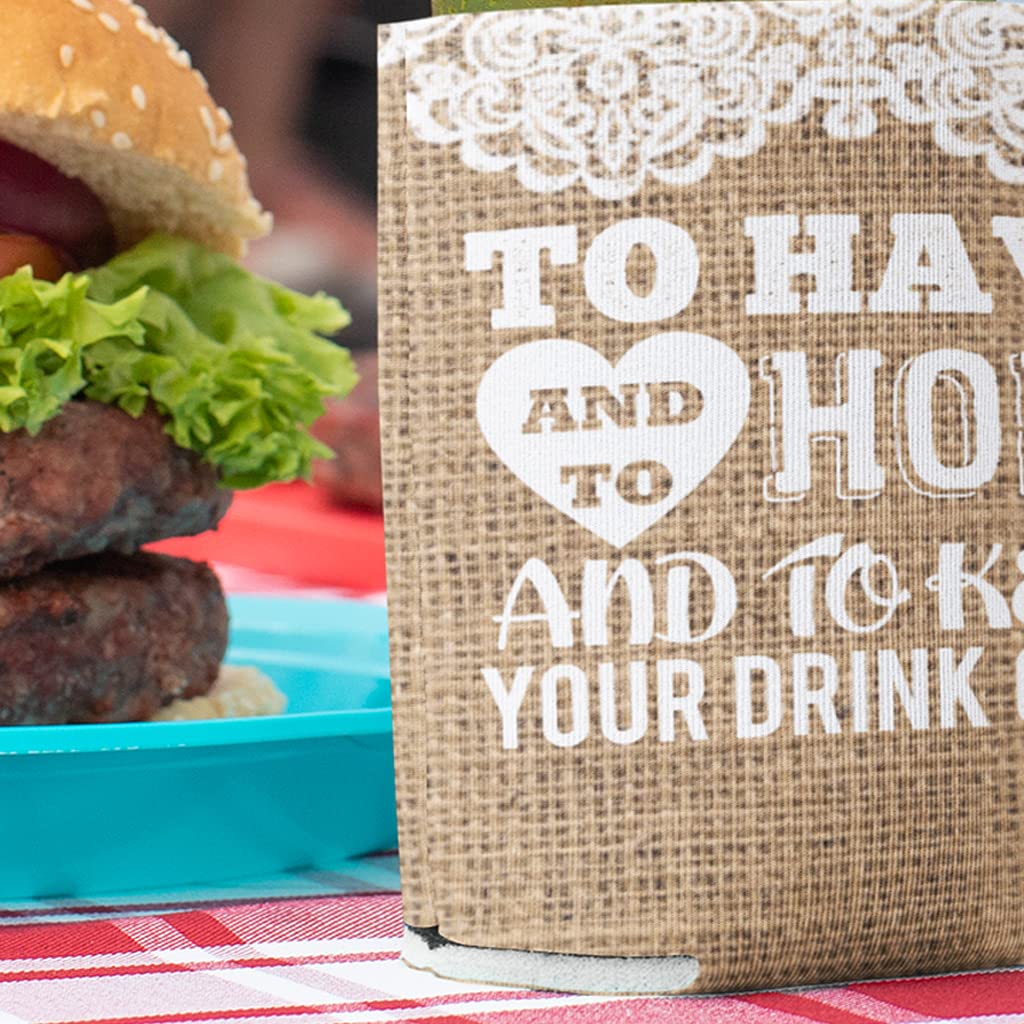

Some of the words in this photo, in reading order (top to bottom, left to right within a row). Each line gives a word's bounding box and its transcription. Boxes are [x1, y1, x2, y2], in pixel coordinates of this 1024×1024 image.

[463, 217, 700, 330] TO
[521, 380, 705, 435] AND
[560, 459, 674, 510] TO
[491, 550, 739, 651] AND
[762, 533, 912, 638] TO
[480, 658, 710, 751] YOUR
[733, 646, 991, 740] DRINK
